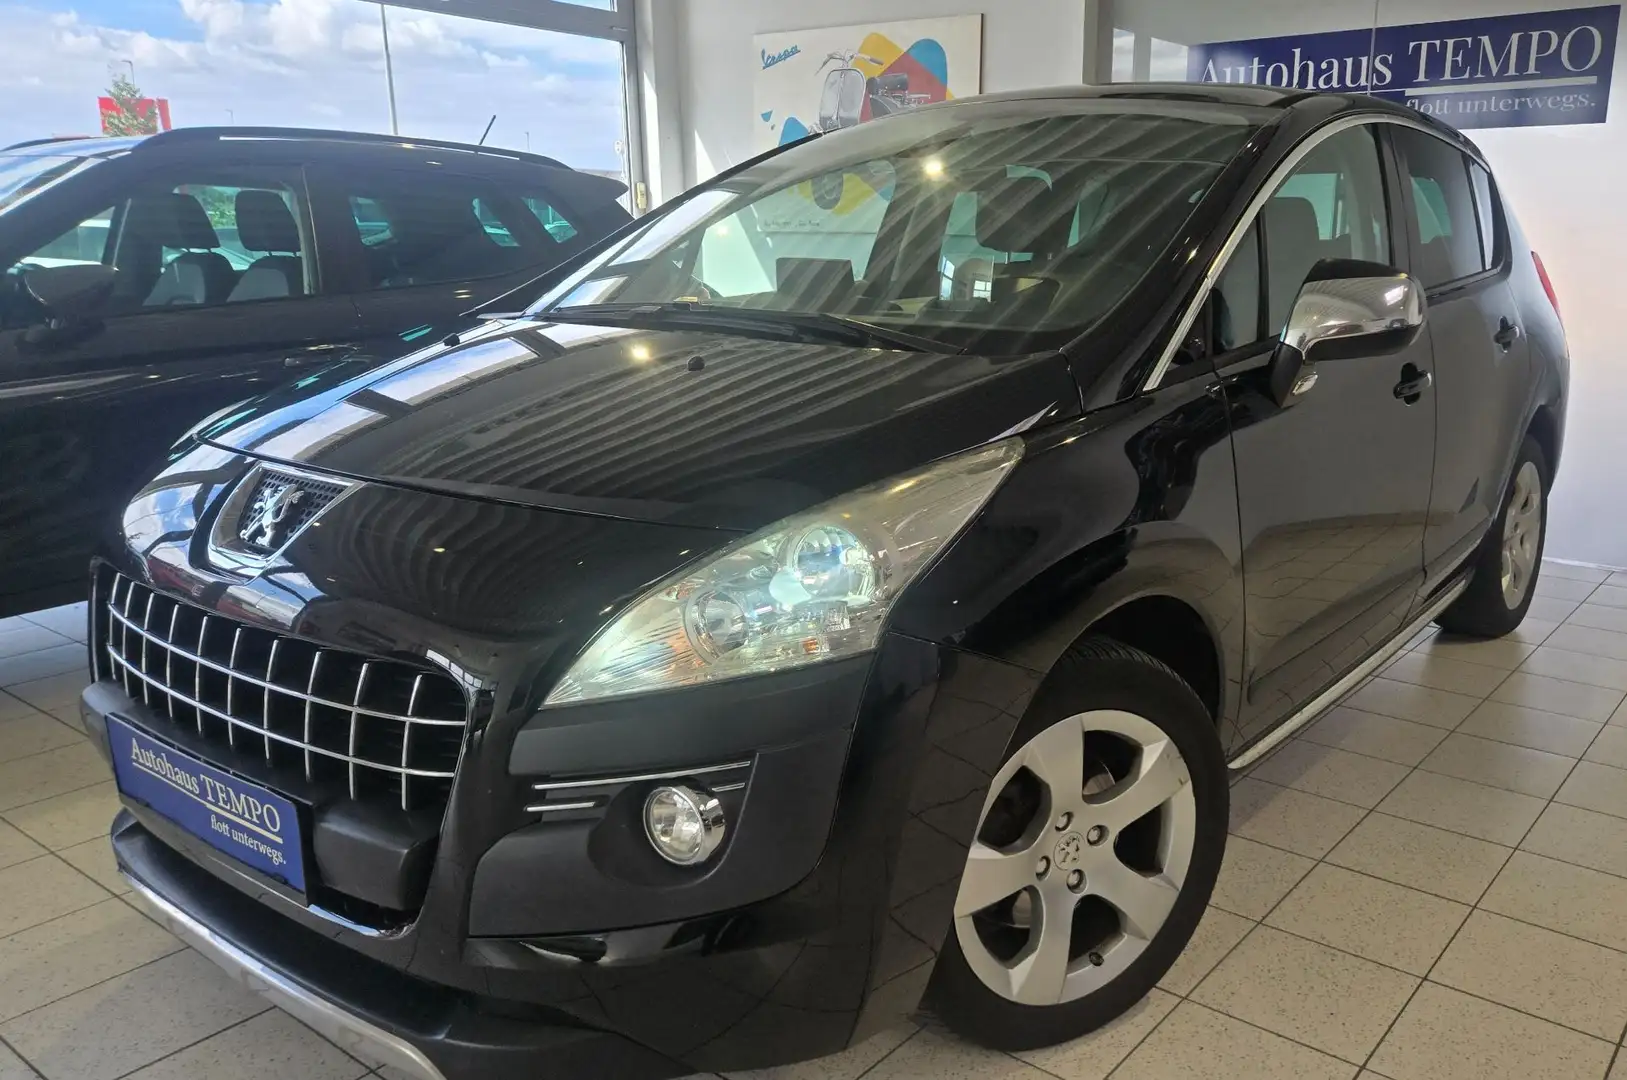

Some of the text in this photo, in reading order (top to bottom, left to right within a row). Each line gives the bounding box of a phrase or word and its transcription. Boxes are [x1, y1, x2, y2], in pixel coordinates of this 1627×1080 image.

[1201, 25, 1601, 90] Autohaus TEMPO
[1457, 92, 1596, 115] unterwegs.
[131, 737, 281, 833] Autohaus TEMPO
[210, 814, 287, 866] flott unterwegs.
